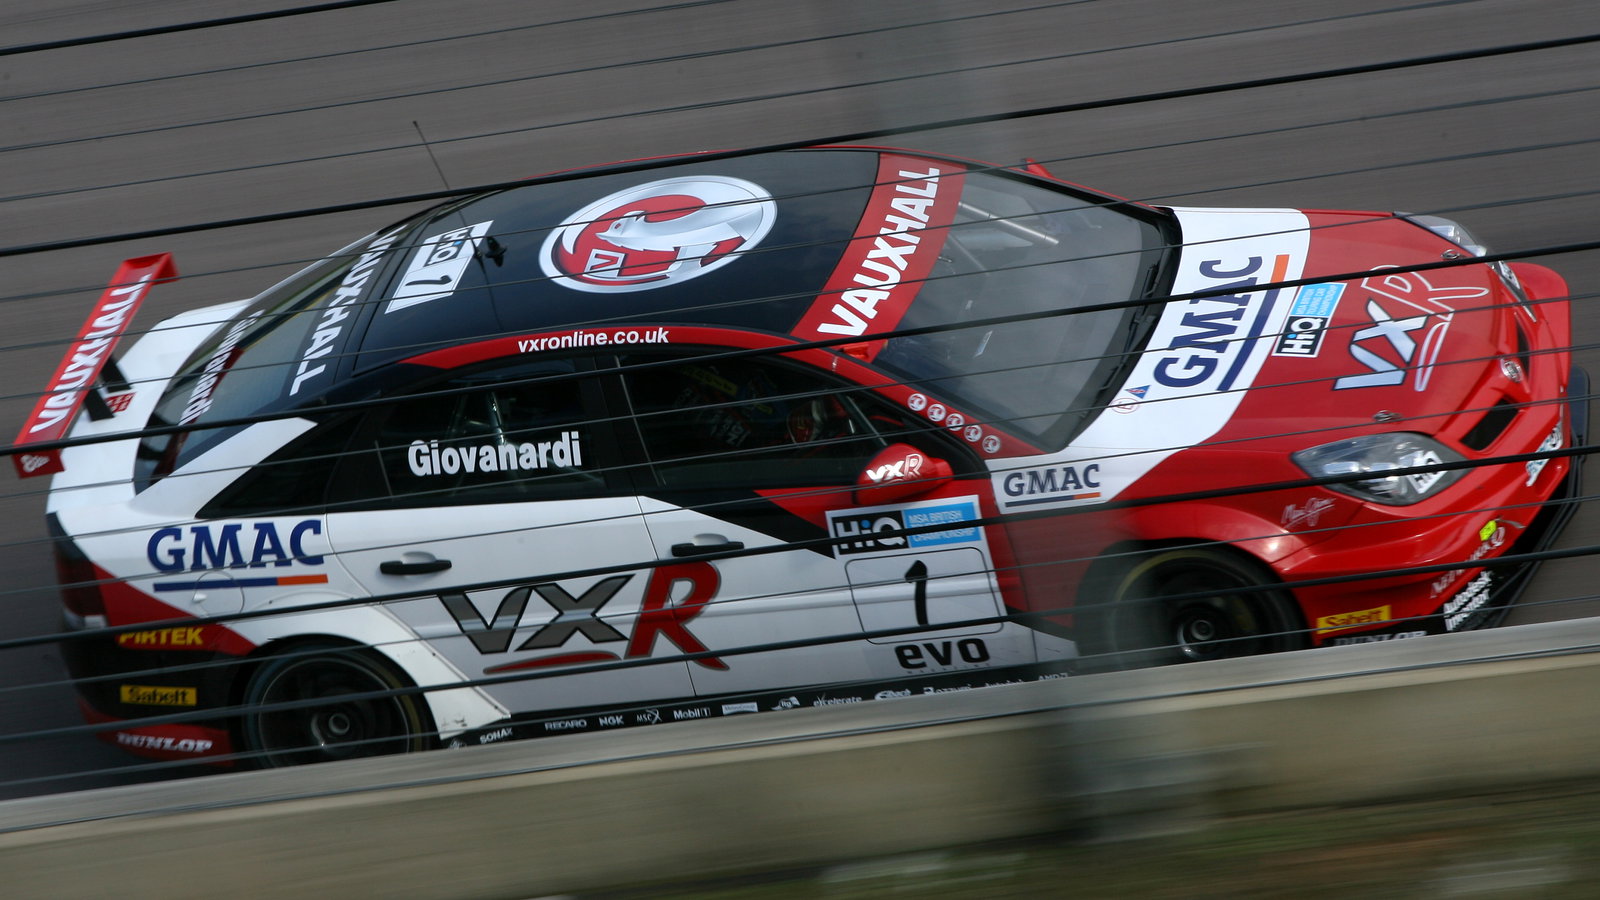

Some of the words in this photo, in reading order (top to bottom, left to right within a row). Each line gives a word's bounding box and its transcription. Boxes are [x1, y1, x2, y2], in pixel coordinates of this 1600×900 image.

[817, 167, 940, 336] VAUXHALL
[290, 223, 409, 397] VAUXHALL
[1153, 255, 1263, 388] GMAC
[1332, 264, 1490, 391] VXR
[518, 327, 669, 353] vxronline.co.uk
[1281, 317, 1324, 354] HiQ
[30, 273, 153, 434] VAUXHALL
[408, 431, 582, 477] Giovanardi
[1003, 463, 1101, 497] GMAC
[147, 520, 326, 574] GMAC
[834, 516, 907, 550] HiQ
[904, 559, 930, 627] 1
[437, 560, 731, 671] VXR
[117, 626, 204, 646] PIRTEK
[894, 638, 990, 669] evo
[128, 687, 190, 704] Sabelt
[480, 727, 513, 744] SONAX
[545, 719, 587, 731] RECARO
[599, 715, 624, 727] NGK
[117, 732, 213, 752] DUNLOP
